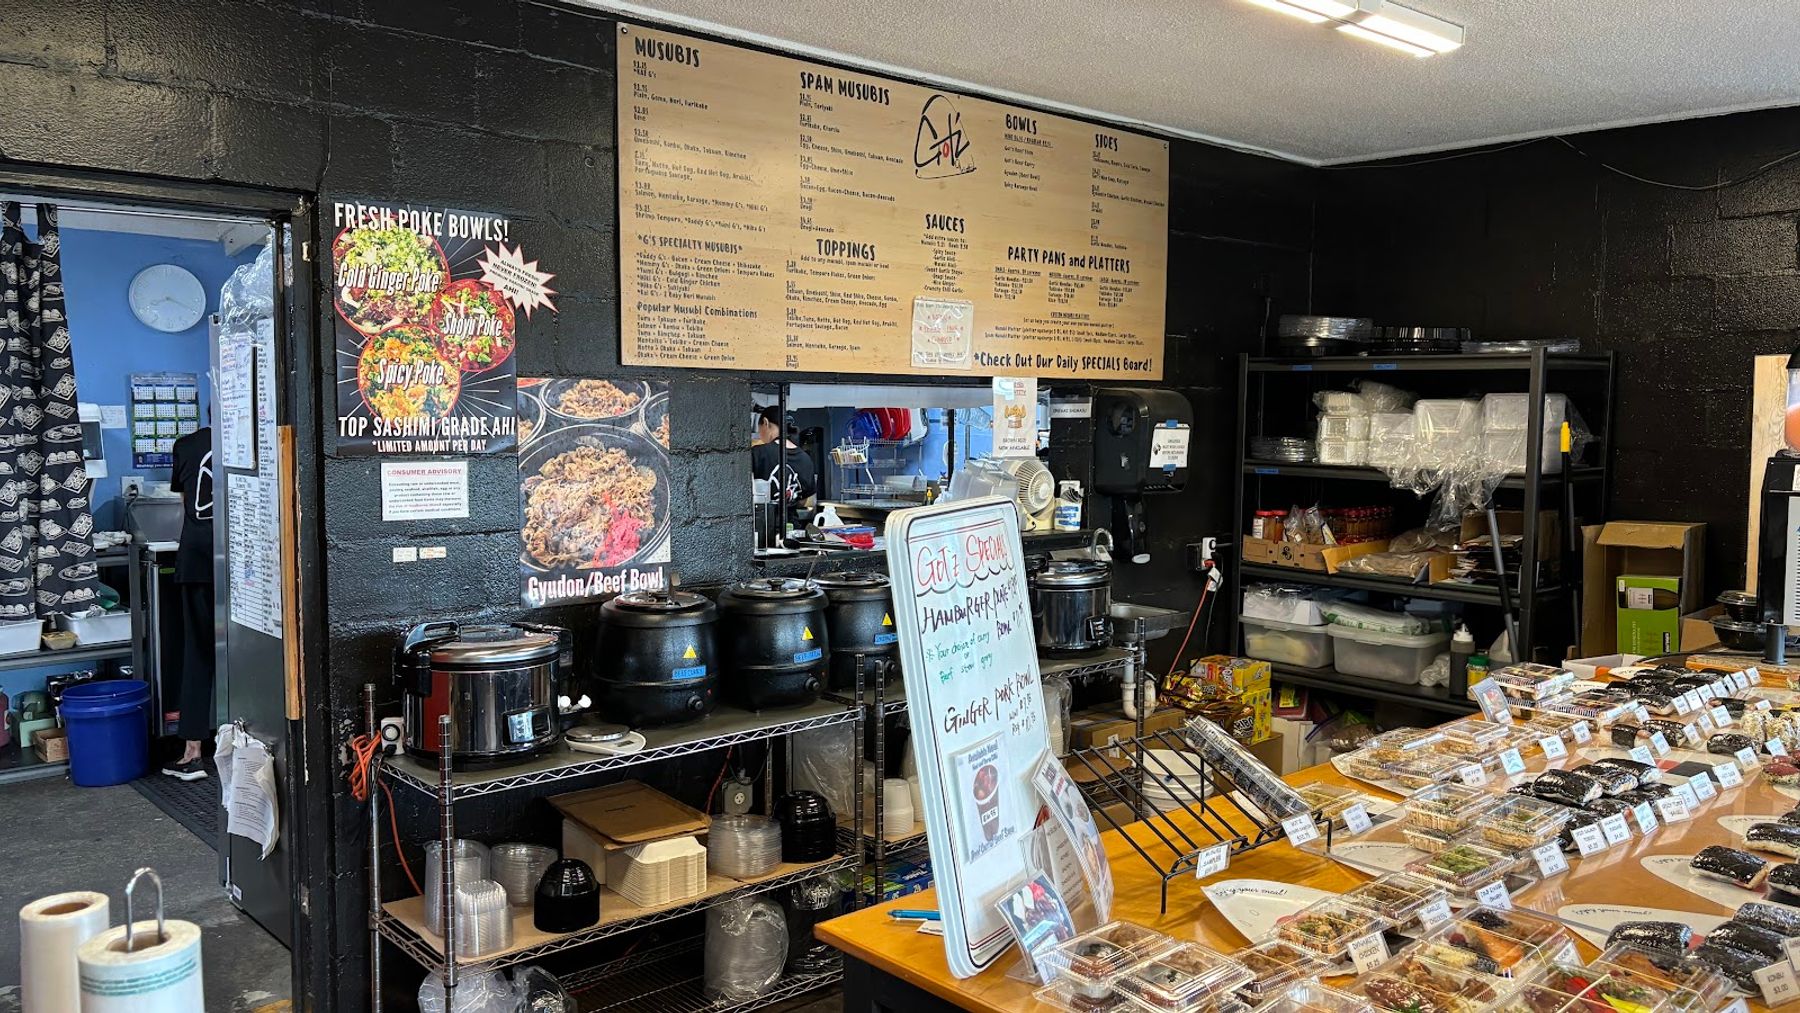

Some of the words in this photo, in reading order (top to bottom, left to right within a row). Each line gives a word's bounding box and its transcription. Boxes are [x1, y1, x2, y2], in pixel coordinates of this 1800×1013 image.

[635, 37, 699, 67] MUSUBIS
[800, 72, 833, 94] SPAM
[838, 79, 889, 105] MUSUBIS
[1006, 113, 1036, 135] BOWLS
[1096, 134, 1117, 152] SIDES
[334, 203, 390, 230] FRESH
[399, 208, 442, 236] POKE
[450, 214, 509, 242] BOWLS!
[926, 213, 964, 233] SAUCES
[660, 236, 702, 250] SPECIALTY
[816, 239, 875, 261] TOPPINGS
[492, 263, 512, 276] NEVER
[501, 260, 521, 272] ALWAYS
[1008, 246, 1039, 263] PARTY
[1043, 251, 1065, 266] PANS
[1069, 256, 1085, 268] and
[1089, 255, 1130, 273] PLATTERS
[338, 263, 365, 288] Cold
[368, 265, 409, 295] Ginger
[411, 270, 439, 292] Poke
[636, 302, 670, 314] Popular
[674, 304, 702, 314] Musubi
[705, 306, 758, 319] Combinations
[444, 314, 476, 338] Shoyu
[478, 316, 502, 336] Poke
[1015, 353, 1032, 367] Out
[1037, 354, 1053, 368] Our
[1057, 355, 1078, 372] Daily
[1082, 357, 1120, 371] SPECIALS
[1124, 357, 1152, 371] Board!
[378, 358, 412, 390] Spicy
[415, 360, 444, 384] Poke
[338, 417, 368, 437] TOP
[373, 417, 435, 437] SASHIMI
[441, 417, 487, 436] GRADE
[492, 417, 515, 435] AHI
[415, 440, 450, 452] AMOUNT
[453, 440, 468, 452] PER
[471, 440, 486, 451] DAY
[528, 570, 626, 606] Gyudon/Beef
[630, 566, 664, 591] Bowl
[922, 592, 993, 634] HAMBURGER
